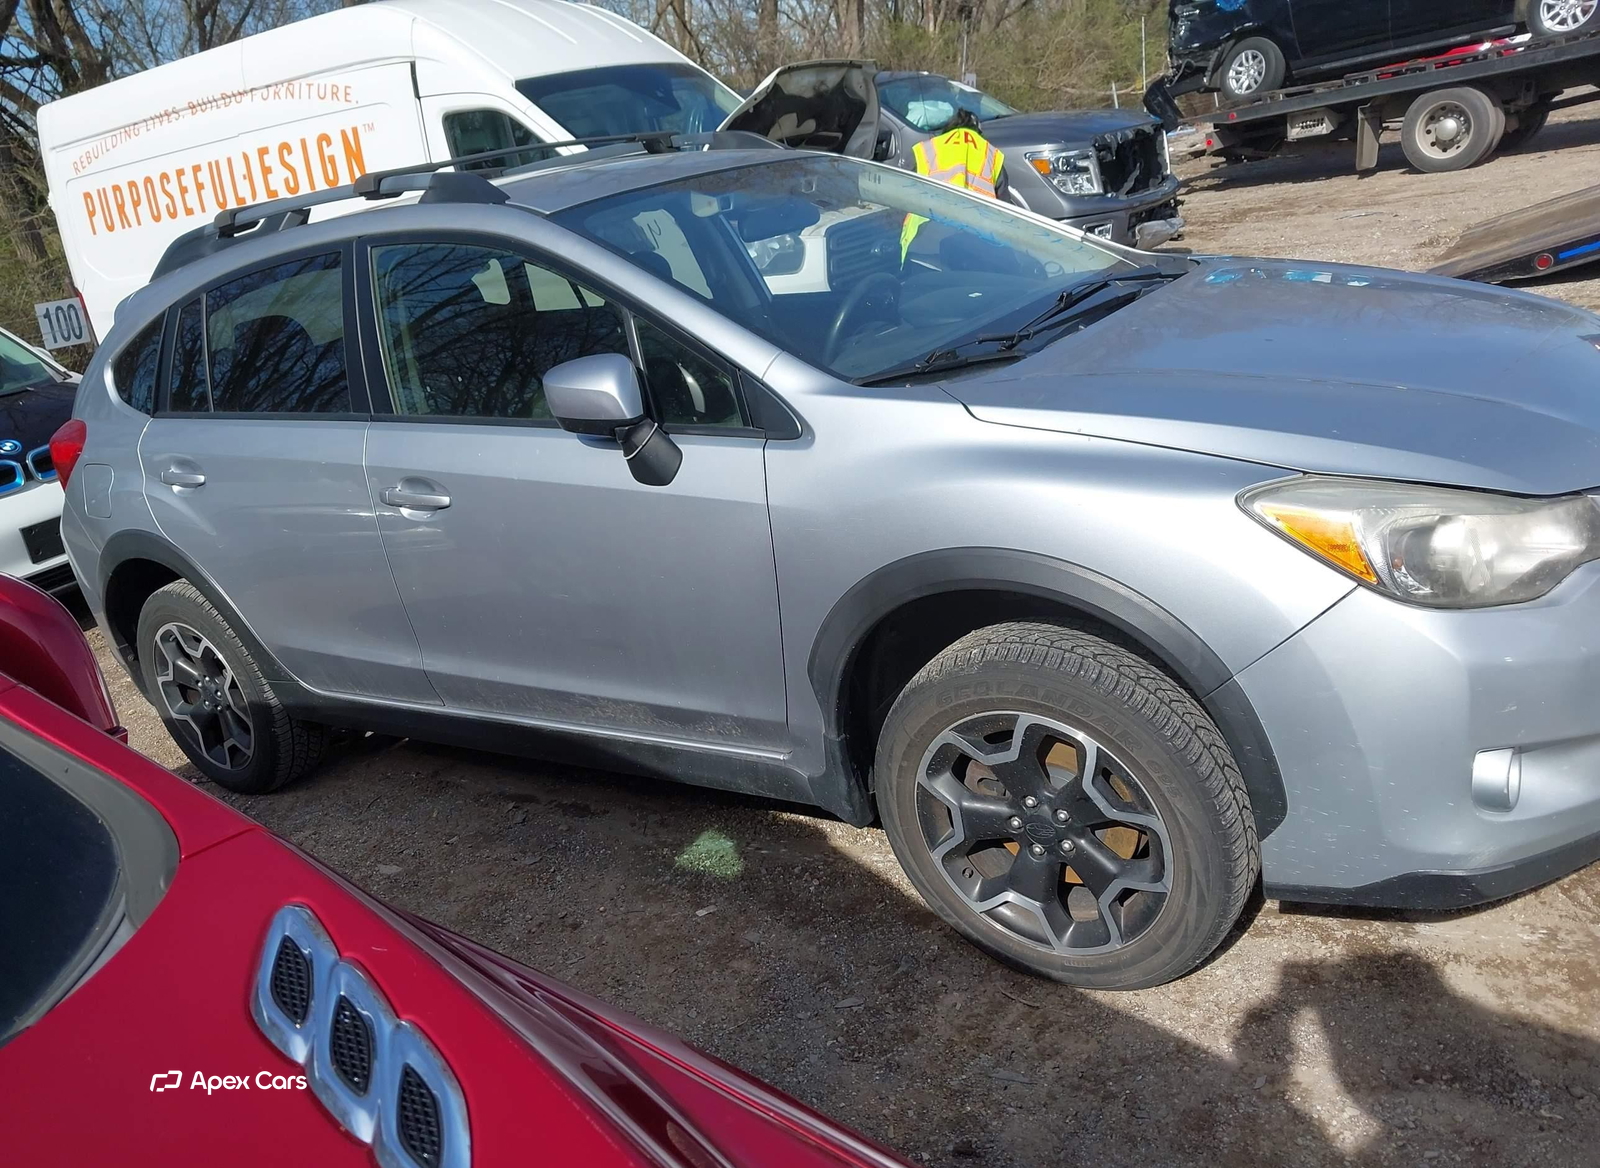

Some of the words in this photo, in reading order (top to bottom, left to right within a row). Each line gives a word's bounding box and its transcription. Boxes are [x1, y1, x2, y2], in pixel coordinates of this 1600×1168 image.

[72, 122, 141, 176] REBUILDING
[43, 303, 83, 344] 100
[935, 680, 1144, 753] GEOLANDAR
